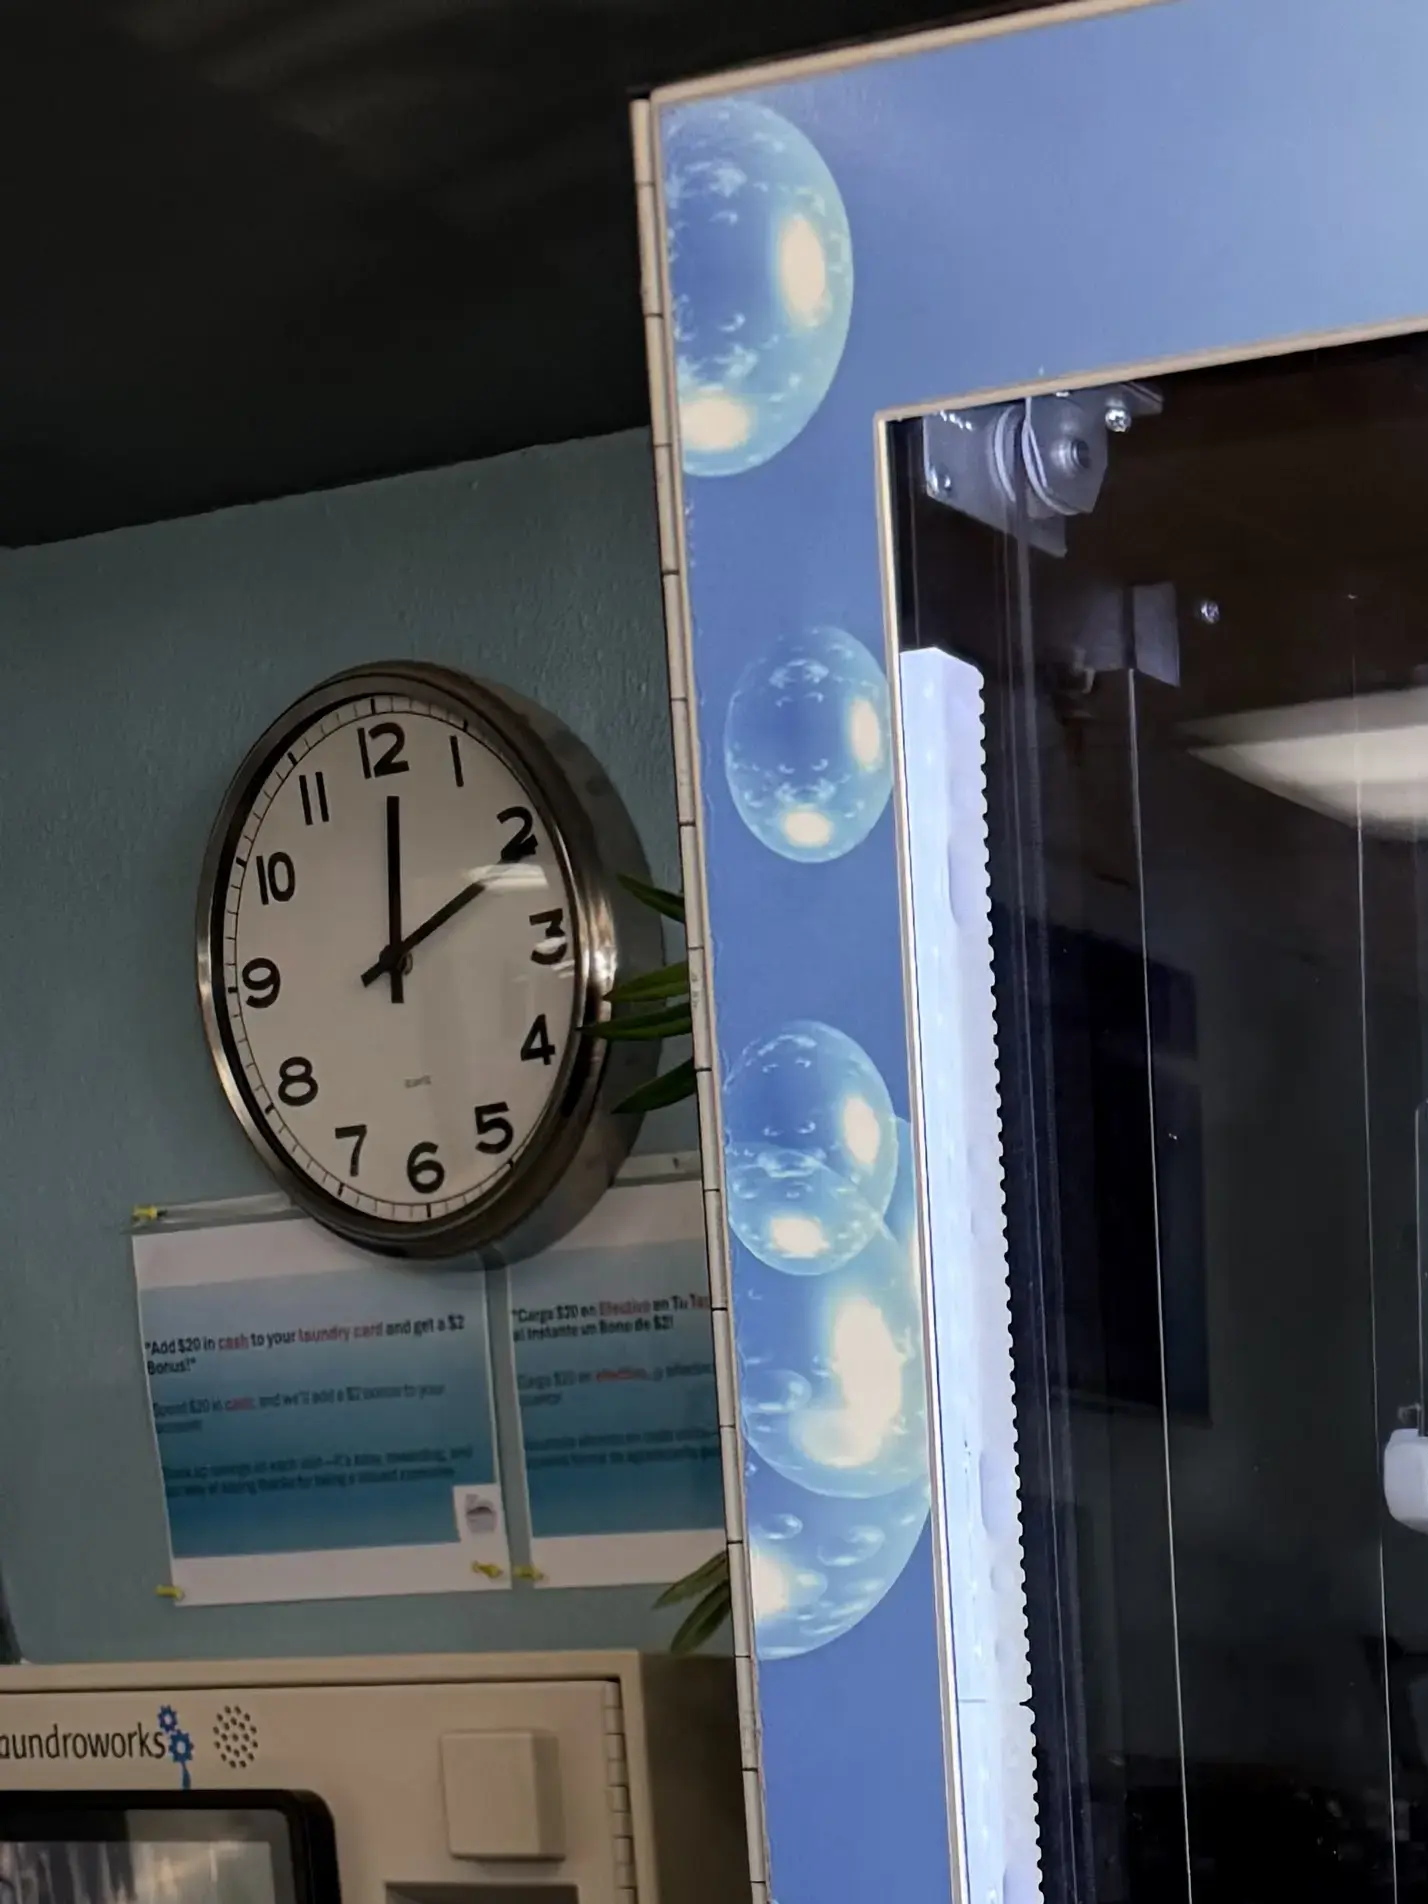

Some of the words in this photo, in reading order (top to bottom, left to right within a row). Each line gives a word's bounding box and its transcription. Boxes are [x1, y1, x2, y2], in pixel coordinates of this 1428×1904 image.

[357, 721, 409, 777] 12
[449, 735, 464, 787] 1
[299, 772, 331, 826] 11
[496, 806, 540, 862] 2
[256, 851, 297, 904] 10
[529, 909, 569, 966] 3
[244, 957, 280, 1009] 9
[519, 1015, 557, 1066] 4
[277, 1056, 319, 1108] 8
[334, 1123, 369, 1177] 7
[474, 1102, 514, 1157] 5
[406, 1140, 445, 1194] 6
[177, 1337, 201, 1354] $20
[202, 1336, 216, 1351] in
[218, 1334, 249, 1350] cash
[251, 1332, 265, 1346] to
[267, 1331, 296, 1348] your
[298, 1324, 351, 1344] laundry
[353, 1322, 384, 1339] card
[386, 1320, 411, 1336] and
[413, 1318, 434, 1337] get
[446, 1314, 465, 1331] $2
